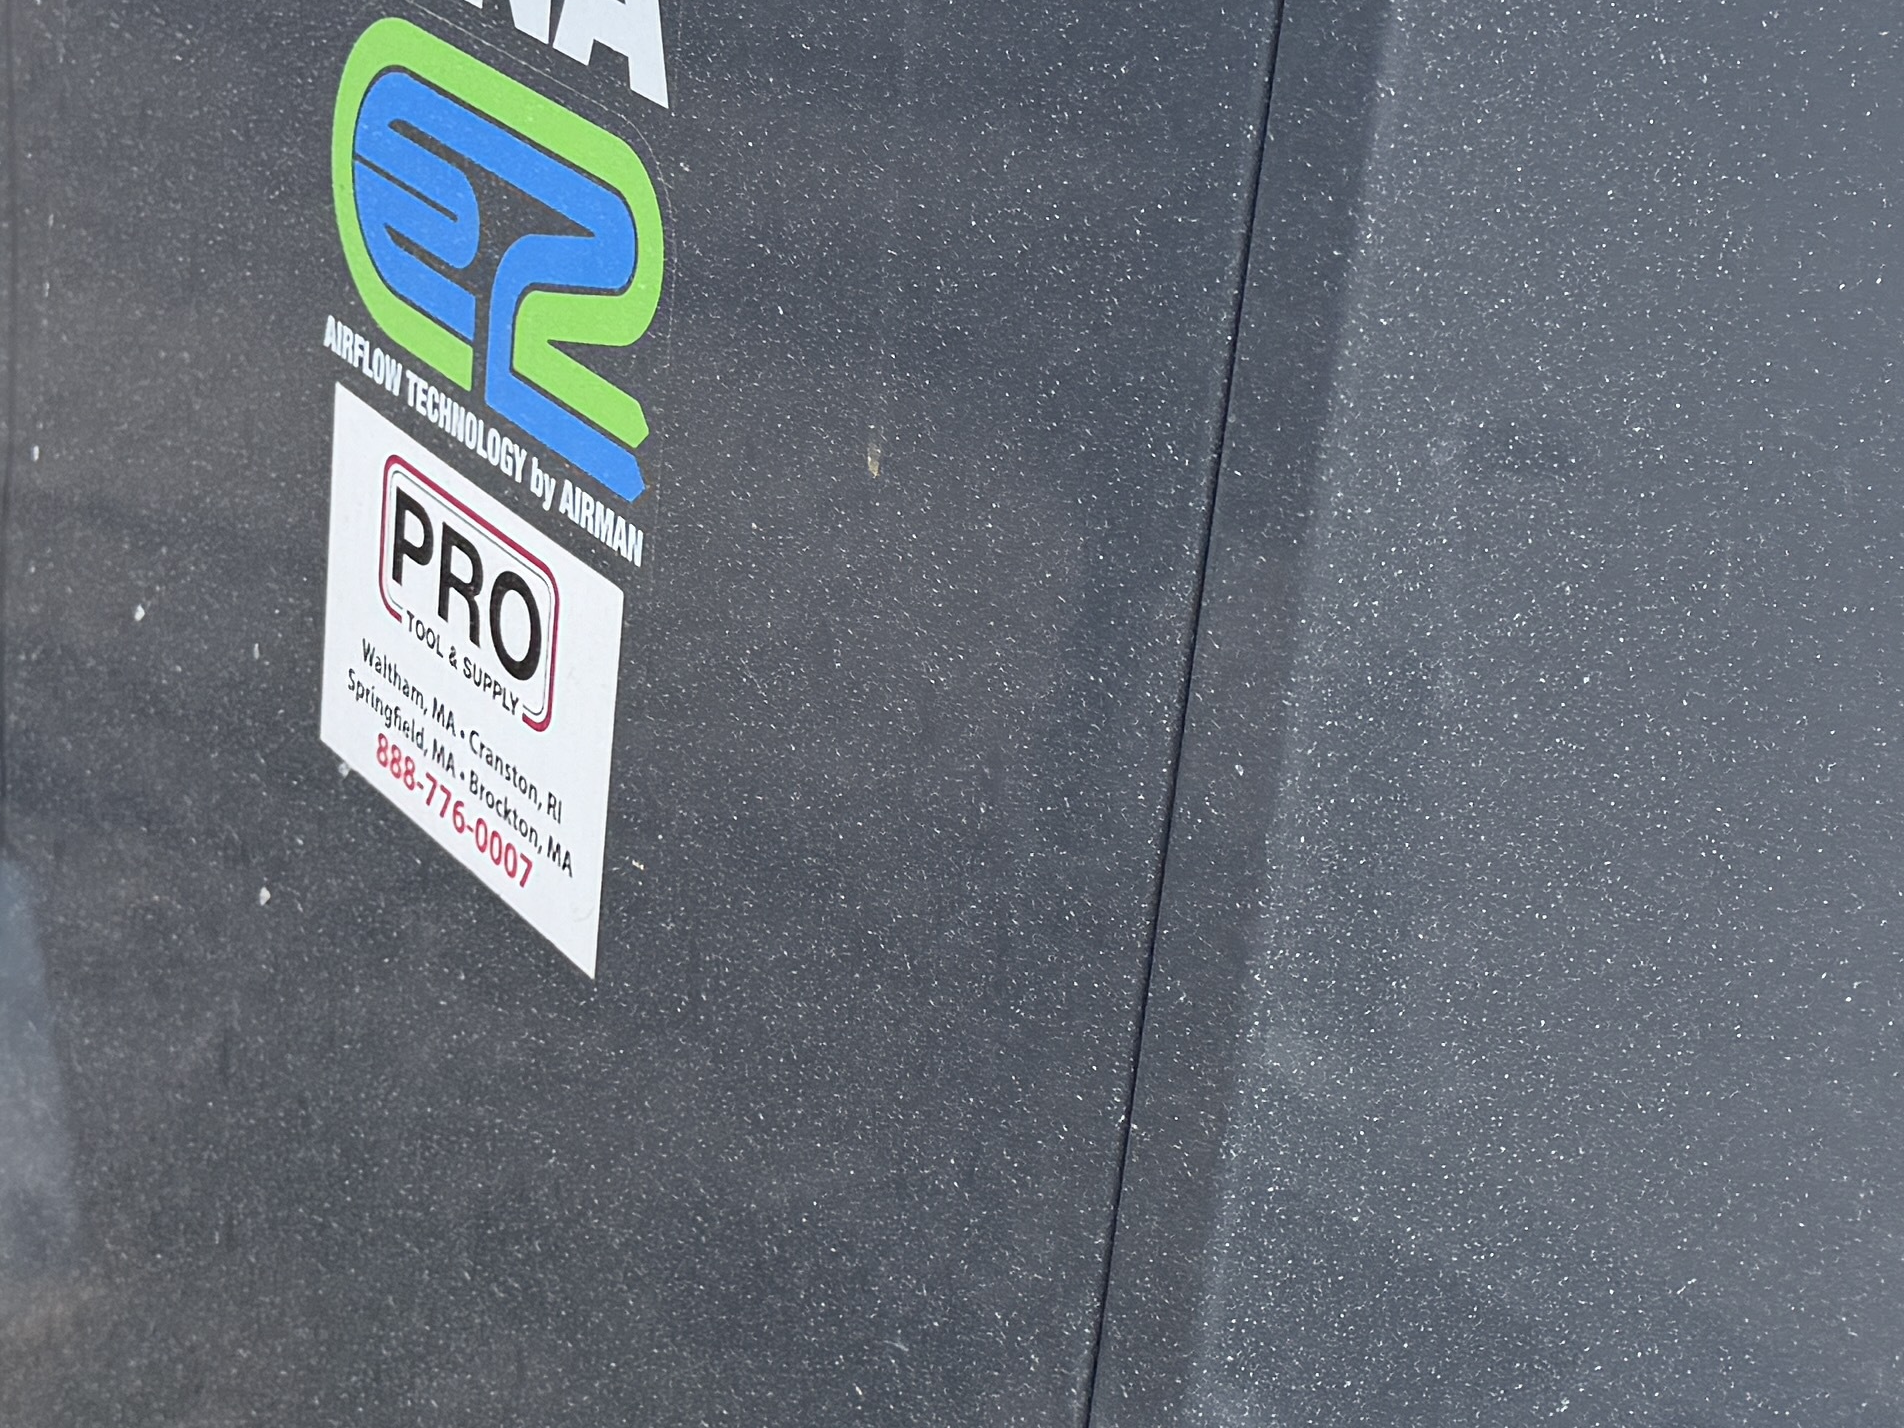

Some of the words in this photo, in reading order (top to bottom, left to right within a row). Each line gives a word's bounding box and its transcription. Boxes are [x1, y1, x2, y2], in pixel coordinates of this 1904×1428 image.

[323, 315, 402, 397] AIRFLOW
[406, 369, 527, 483] TECHNOLOGY
[530, 456, 557, 512] by
[559, 479, 644, 568] AIRMAN
[390, 486, 542, 681] PRO
[406, 609, 444, 659] TOOL
[448, 645, 458, 670] &
[462, 657, 519, 715] SUPPLY
[348, 668, 428, 757] Springfield,
[432, 738, 456, 778] MA
[469, 769, 543, 855] Brockton,
[547, 835, 573, 878] MA
[362, 638, 428, 715] Waltham,
[432, 696, 456, 737] MA
[469, 730, 543, 811] Cranston,
[547, 791, 563, 825] RI
[376, 733, 533, 889] 888-776-0007
